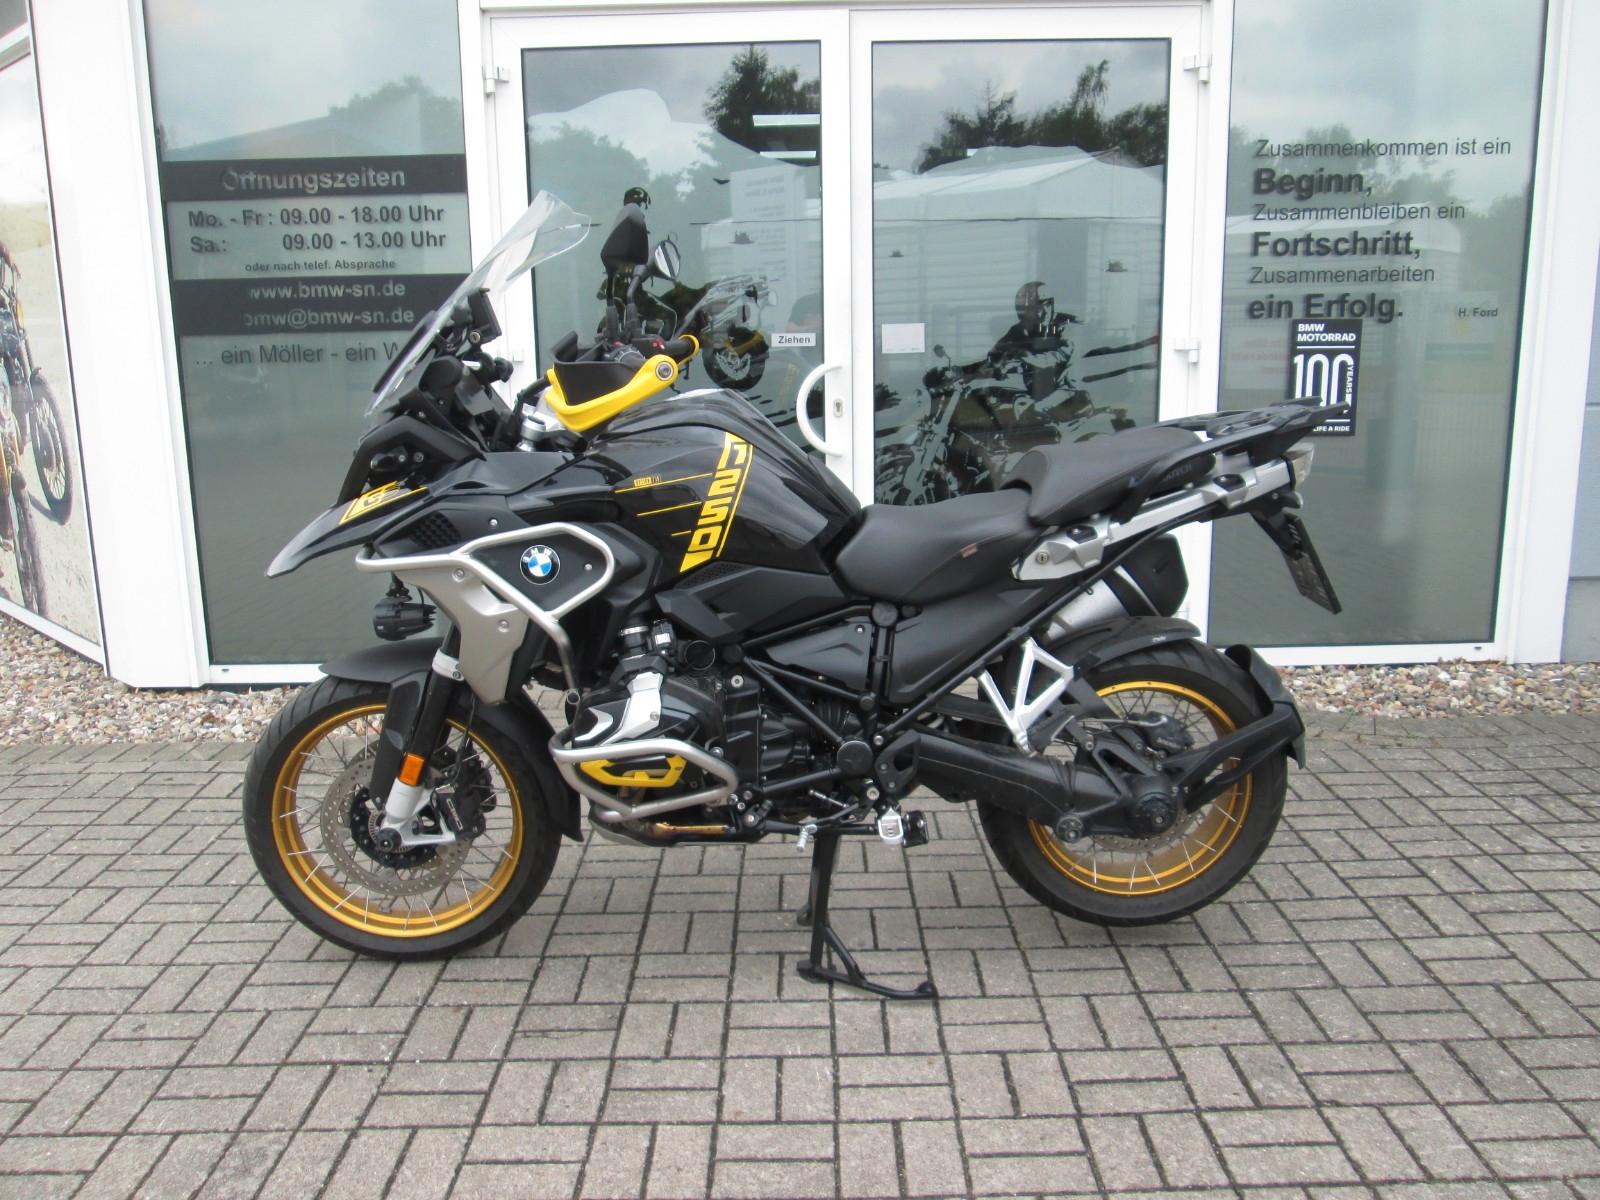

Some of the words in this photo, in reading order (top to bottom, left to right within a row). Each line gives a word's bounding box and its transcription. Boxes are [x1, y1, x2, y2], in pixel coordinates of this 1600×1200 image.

[1254, 139, 1449, 158] Zusammenkommen
[1455, 138, 1476, 155] ist
[1483, 138, 1511, 154] ein
[1253, 167, 1373, 200] Beginn,
[188, 210, 223, 228] Mo.
[280, 207, 331, 225] 09.00
[351, 205, 401, 223] 18.00
[408, 204, 444, 222] Uhr
[1252, 202, 1430, 221] Zusammenbleiben
[1437, 203, 1465, 219] ein
[190, 235, 227, 253] Sa.:
[282, 233, 333, 251] 09.00
[353, 232, 403, 249] 13.00
[410, 231, 446, 248] Uhr
[1252, 230, 1421, 259] Fortschritt,
[244, 261, 270, 272] oder
[273, 260, 300, 271] nach
[303, 260, 331, 271] telef.
[334, 259, 396, 271] Absprache
[1249, 266, 1435, 284] Zusammenarbeiten
[250, 280, 406, 300] www.bmw-sn.de
[1248, 294, 1294, 319] ein
[1303, 292, 1403, 323] Erfolg.
[1473, 307, 1498, 318] Ford
[1297, 333, 1356, 342] MOTORRAD
[1298, 323, 1325, 332] BMW
[778, 335, 811, 344] Ziehen
[221, 346, 251, 365] ein
[259, 344, 323, 364] Möller
[345, 343, 376, 361] ein
